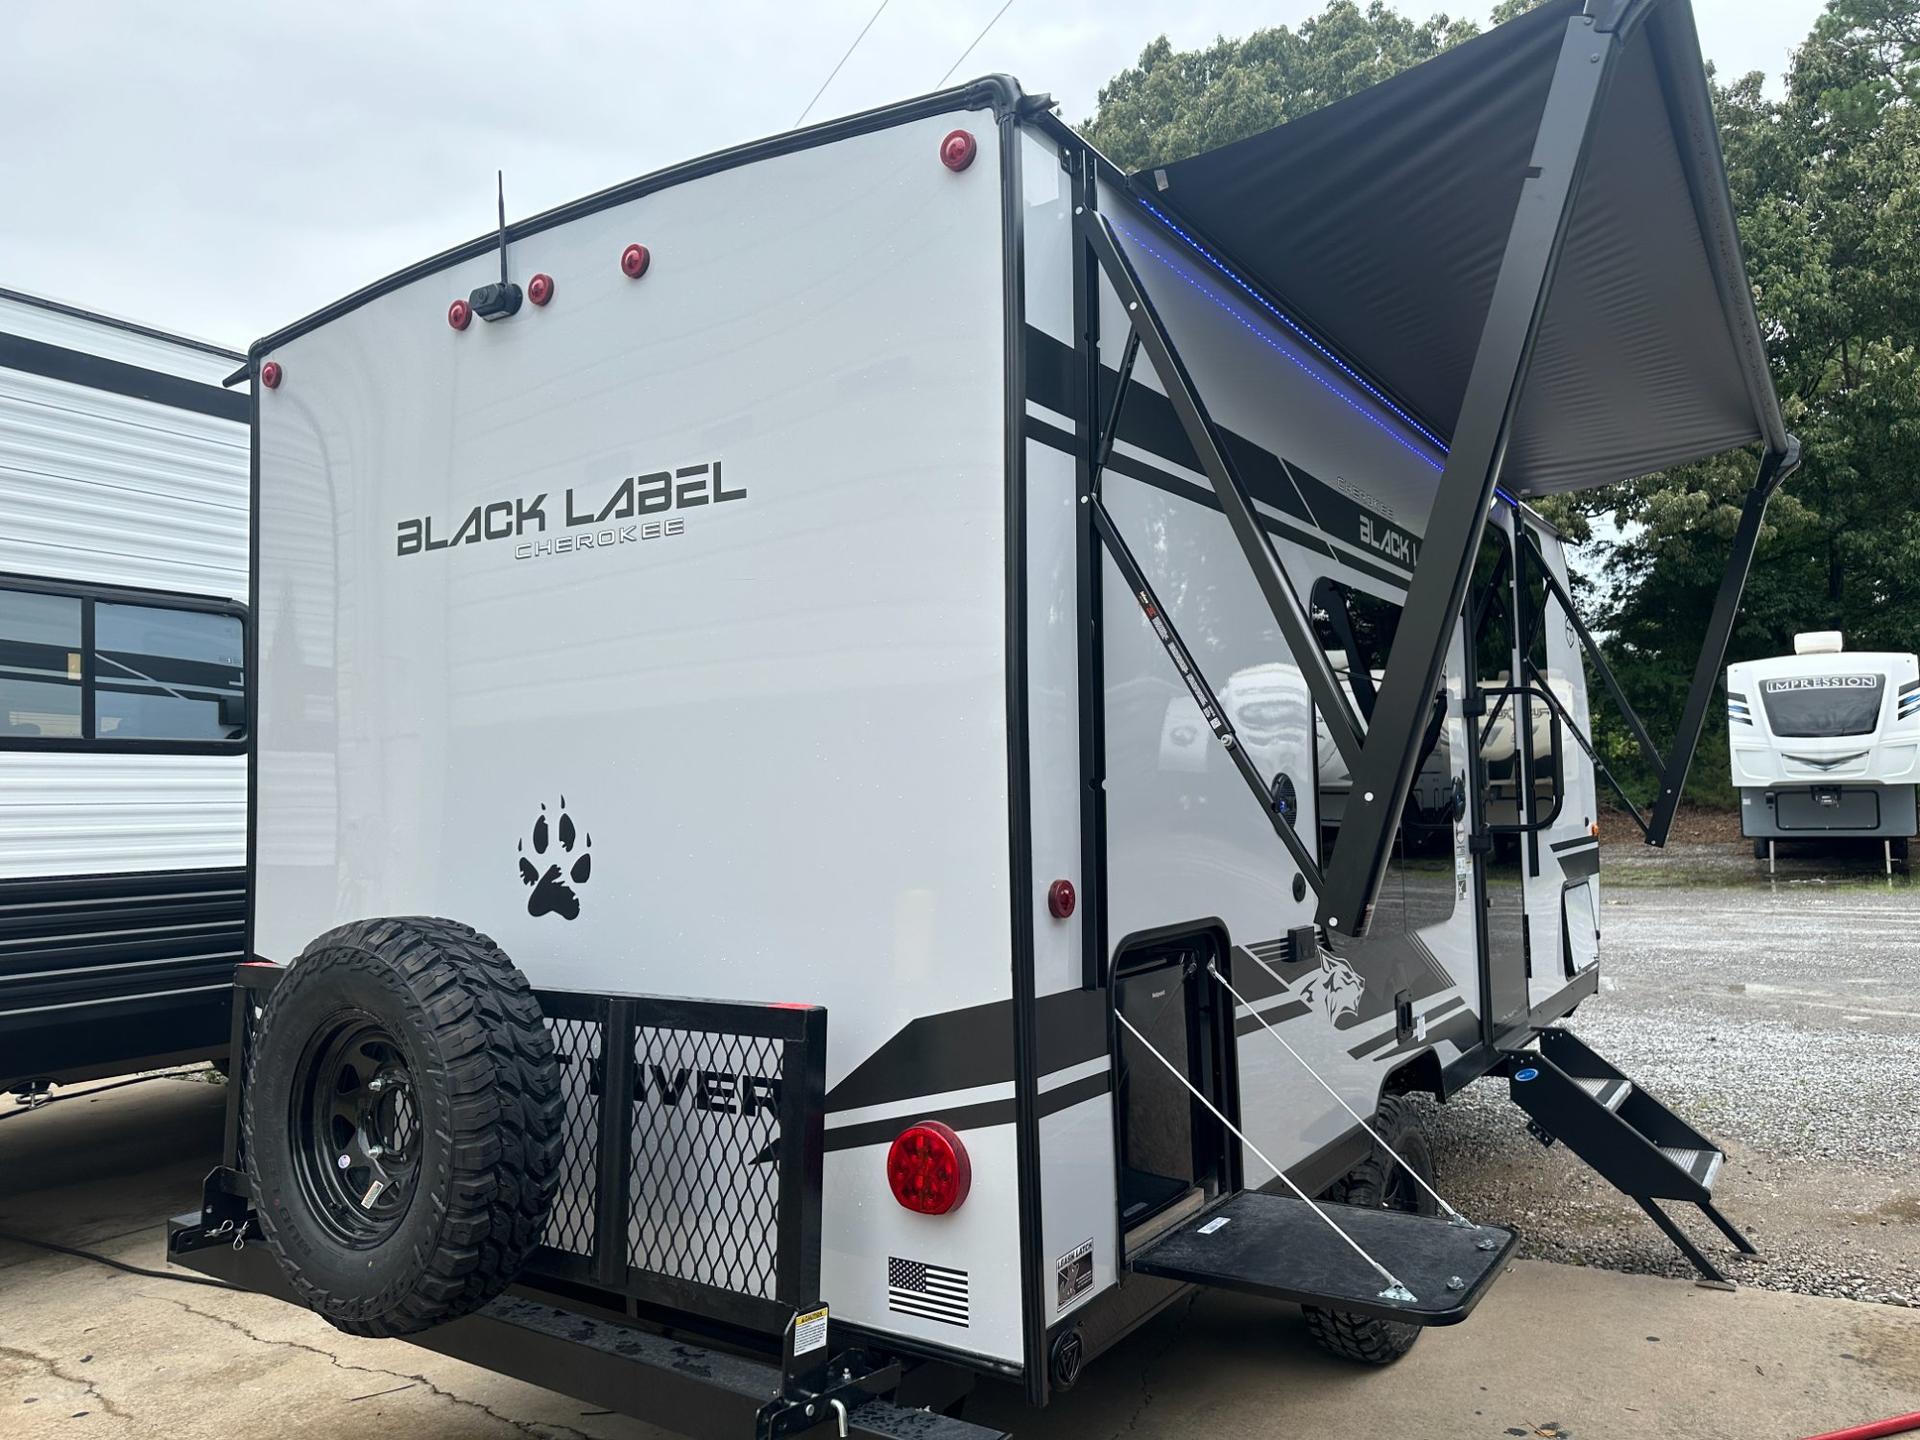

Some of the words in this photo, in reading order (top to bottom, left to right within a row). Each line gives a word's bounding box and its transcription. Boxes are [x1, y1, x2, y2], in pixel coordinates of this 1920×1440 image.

[397, 493, 548, 556] BLACK
[566, 461, 747, 527] LABEL
[515, 517, 685, 559] CHEROKEE
[1360, 515, 1409, 564] BLACK
[1769, 676, 1875, 692] IMPRESSION
